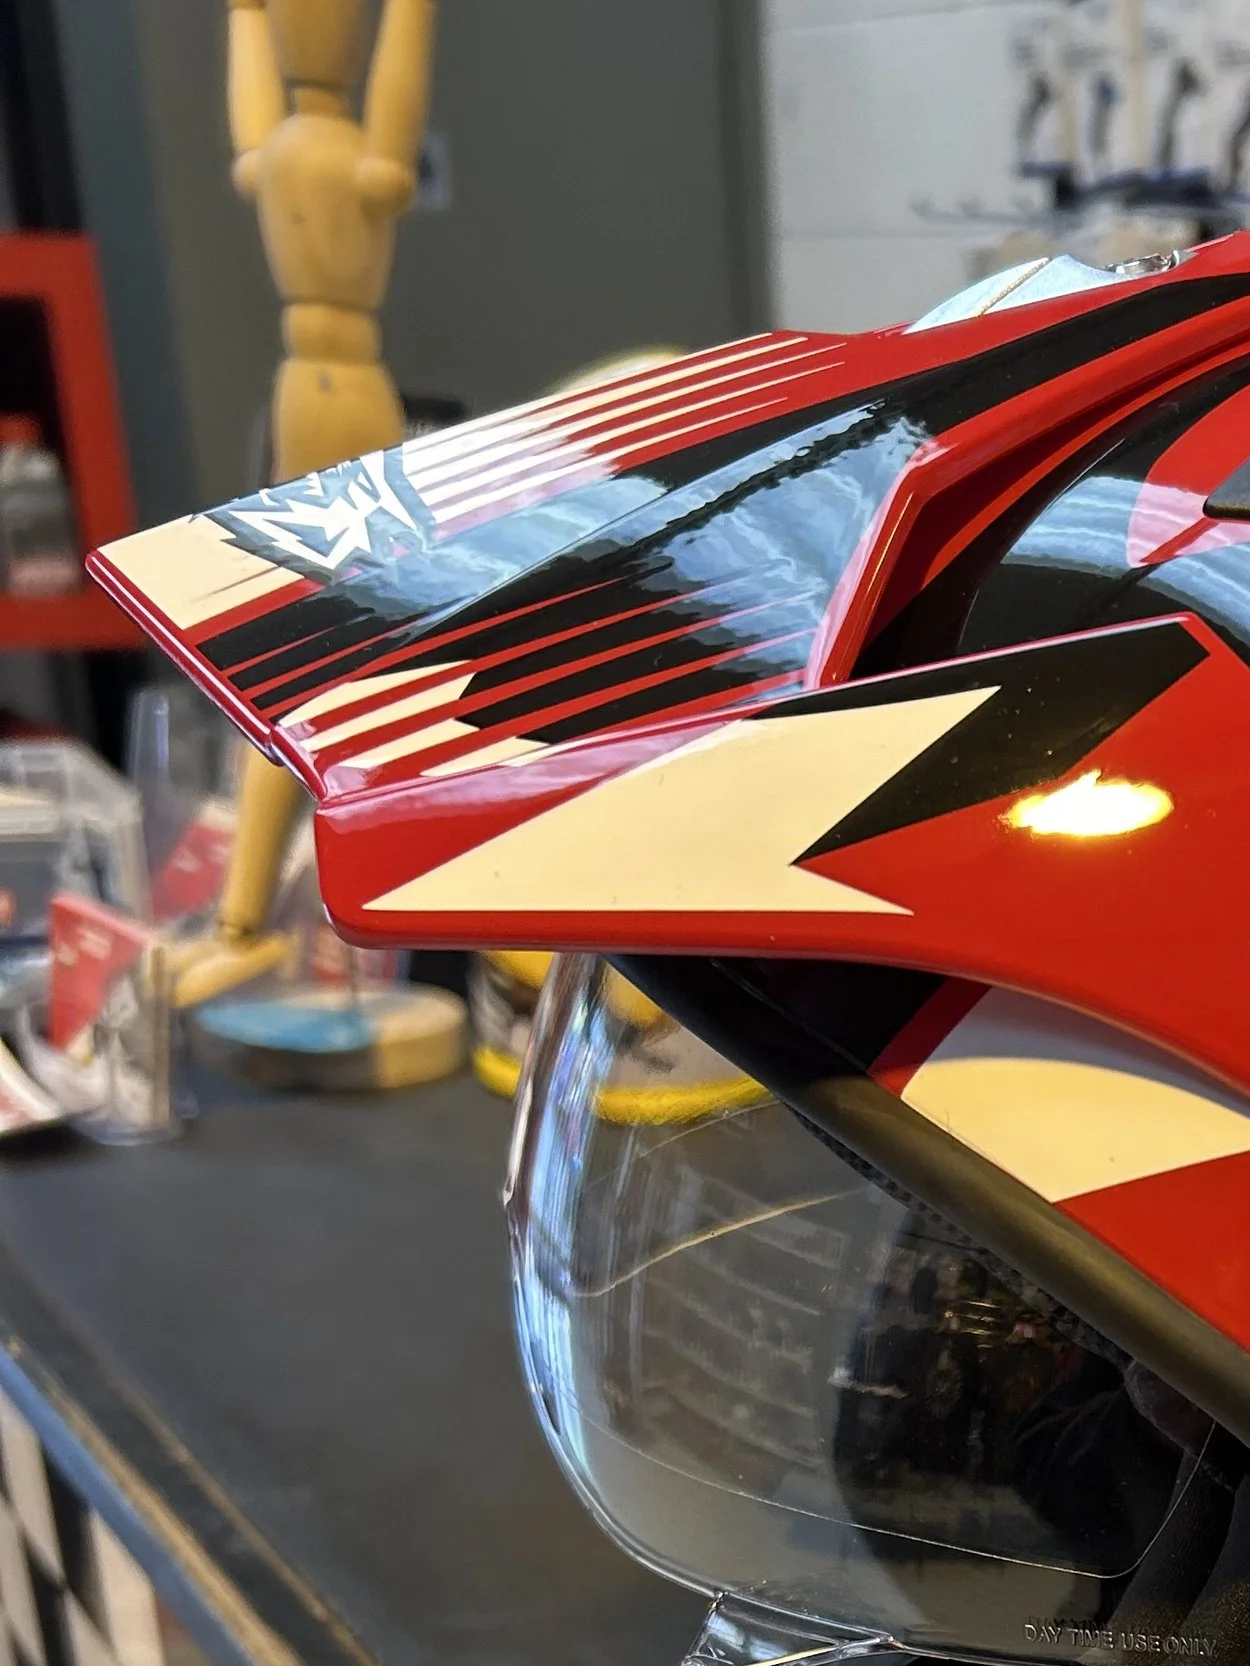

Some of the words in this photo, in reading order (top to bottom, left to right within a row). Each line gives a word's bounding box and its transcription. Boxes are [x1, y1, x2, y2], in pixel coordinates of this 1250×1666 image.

[1024, 1623, 1062, 1644] DAY
[1067, 1627, 1113, 1649] TIME
[1121, 1632, 1161, 1652] USE
[1162, 1636, 1217, 1657] ONLY
